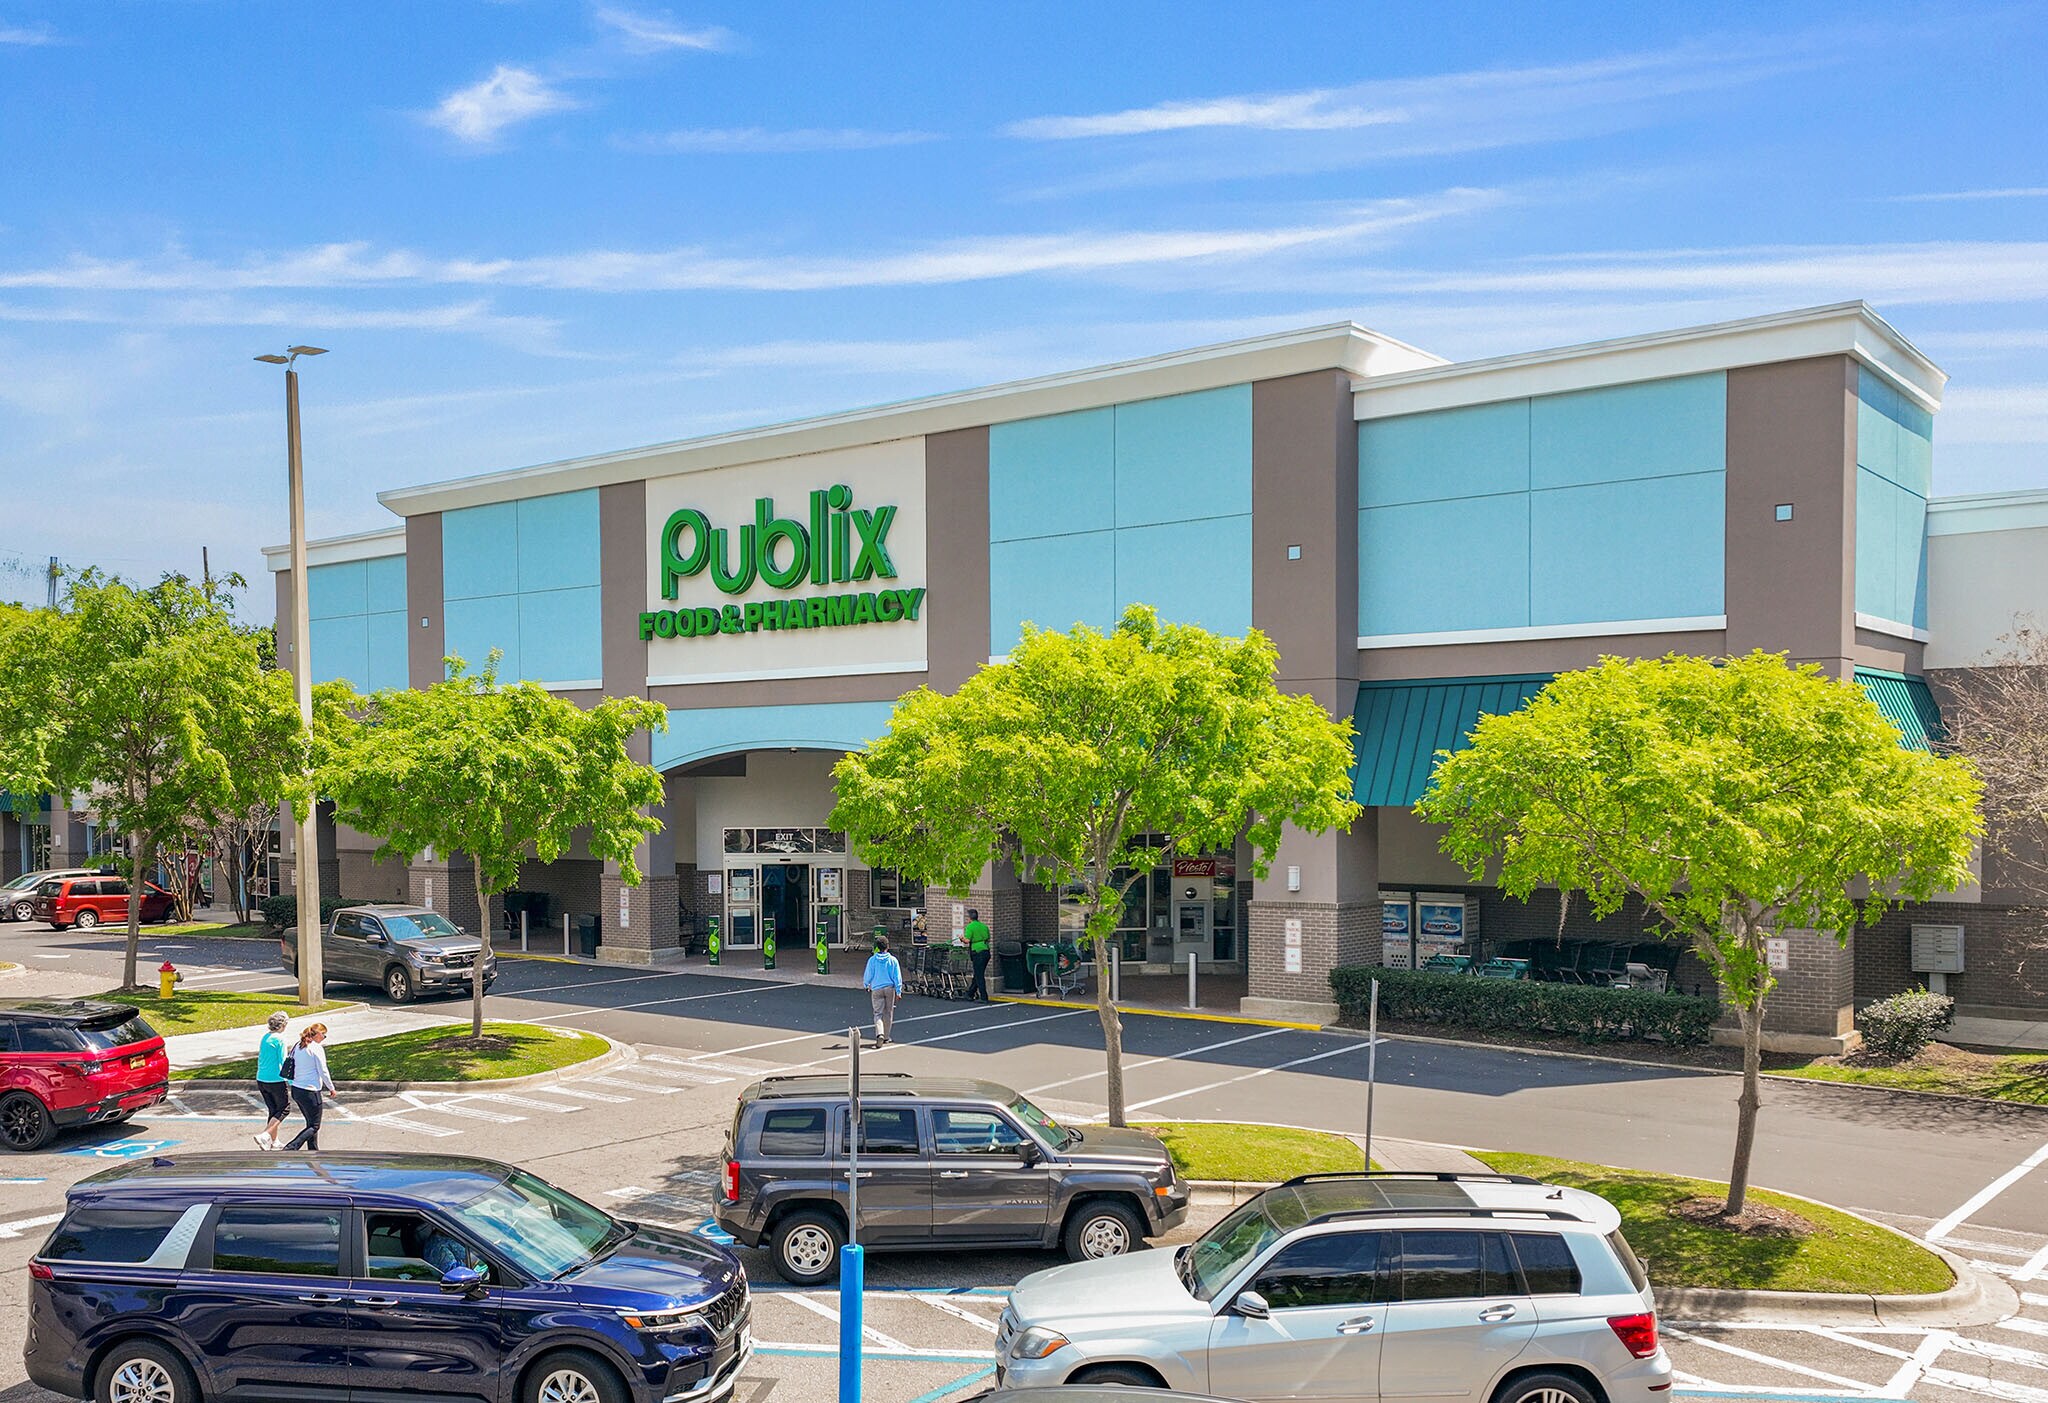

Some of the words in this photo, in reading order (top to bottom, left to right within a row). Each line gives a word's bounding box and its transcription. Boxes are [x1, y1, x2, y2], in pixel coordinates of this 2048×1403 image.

[661, 484, 898, 600] Publix
[744, 588, 926, 633] PHARMACY
[775, 833, 794, 841] EXIT
